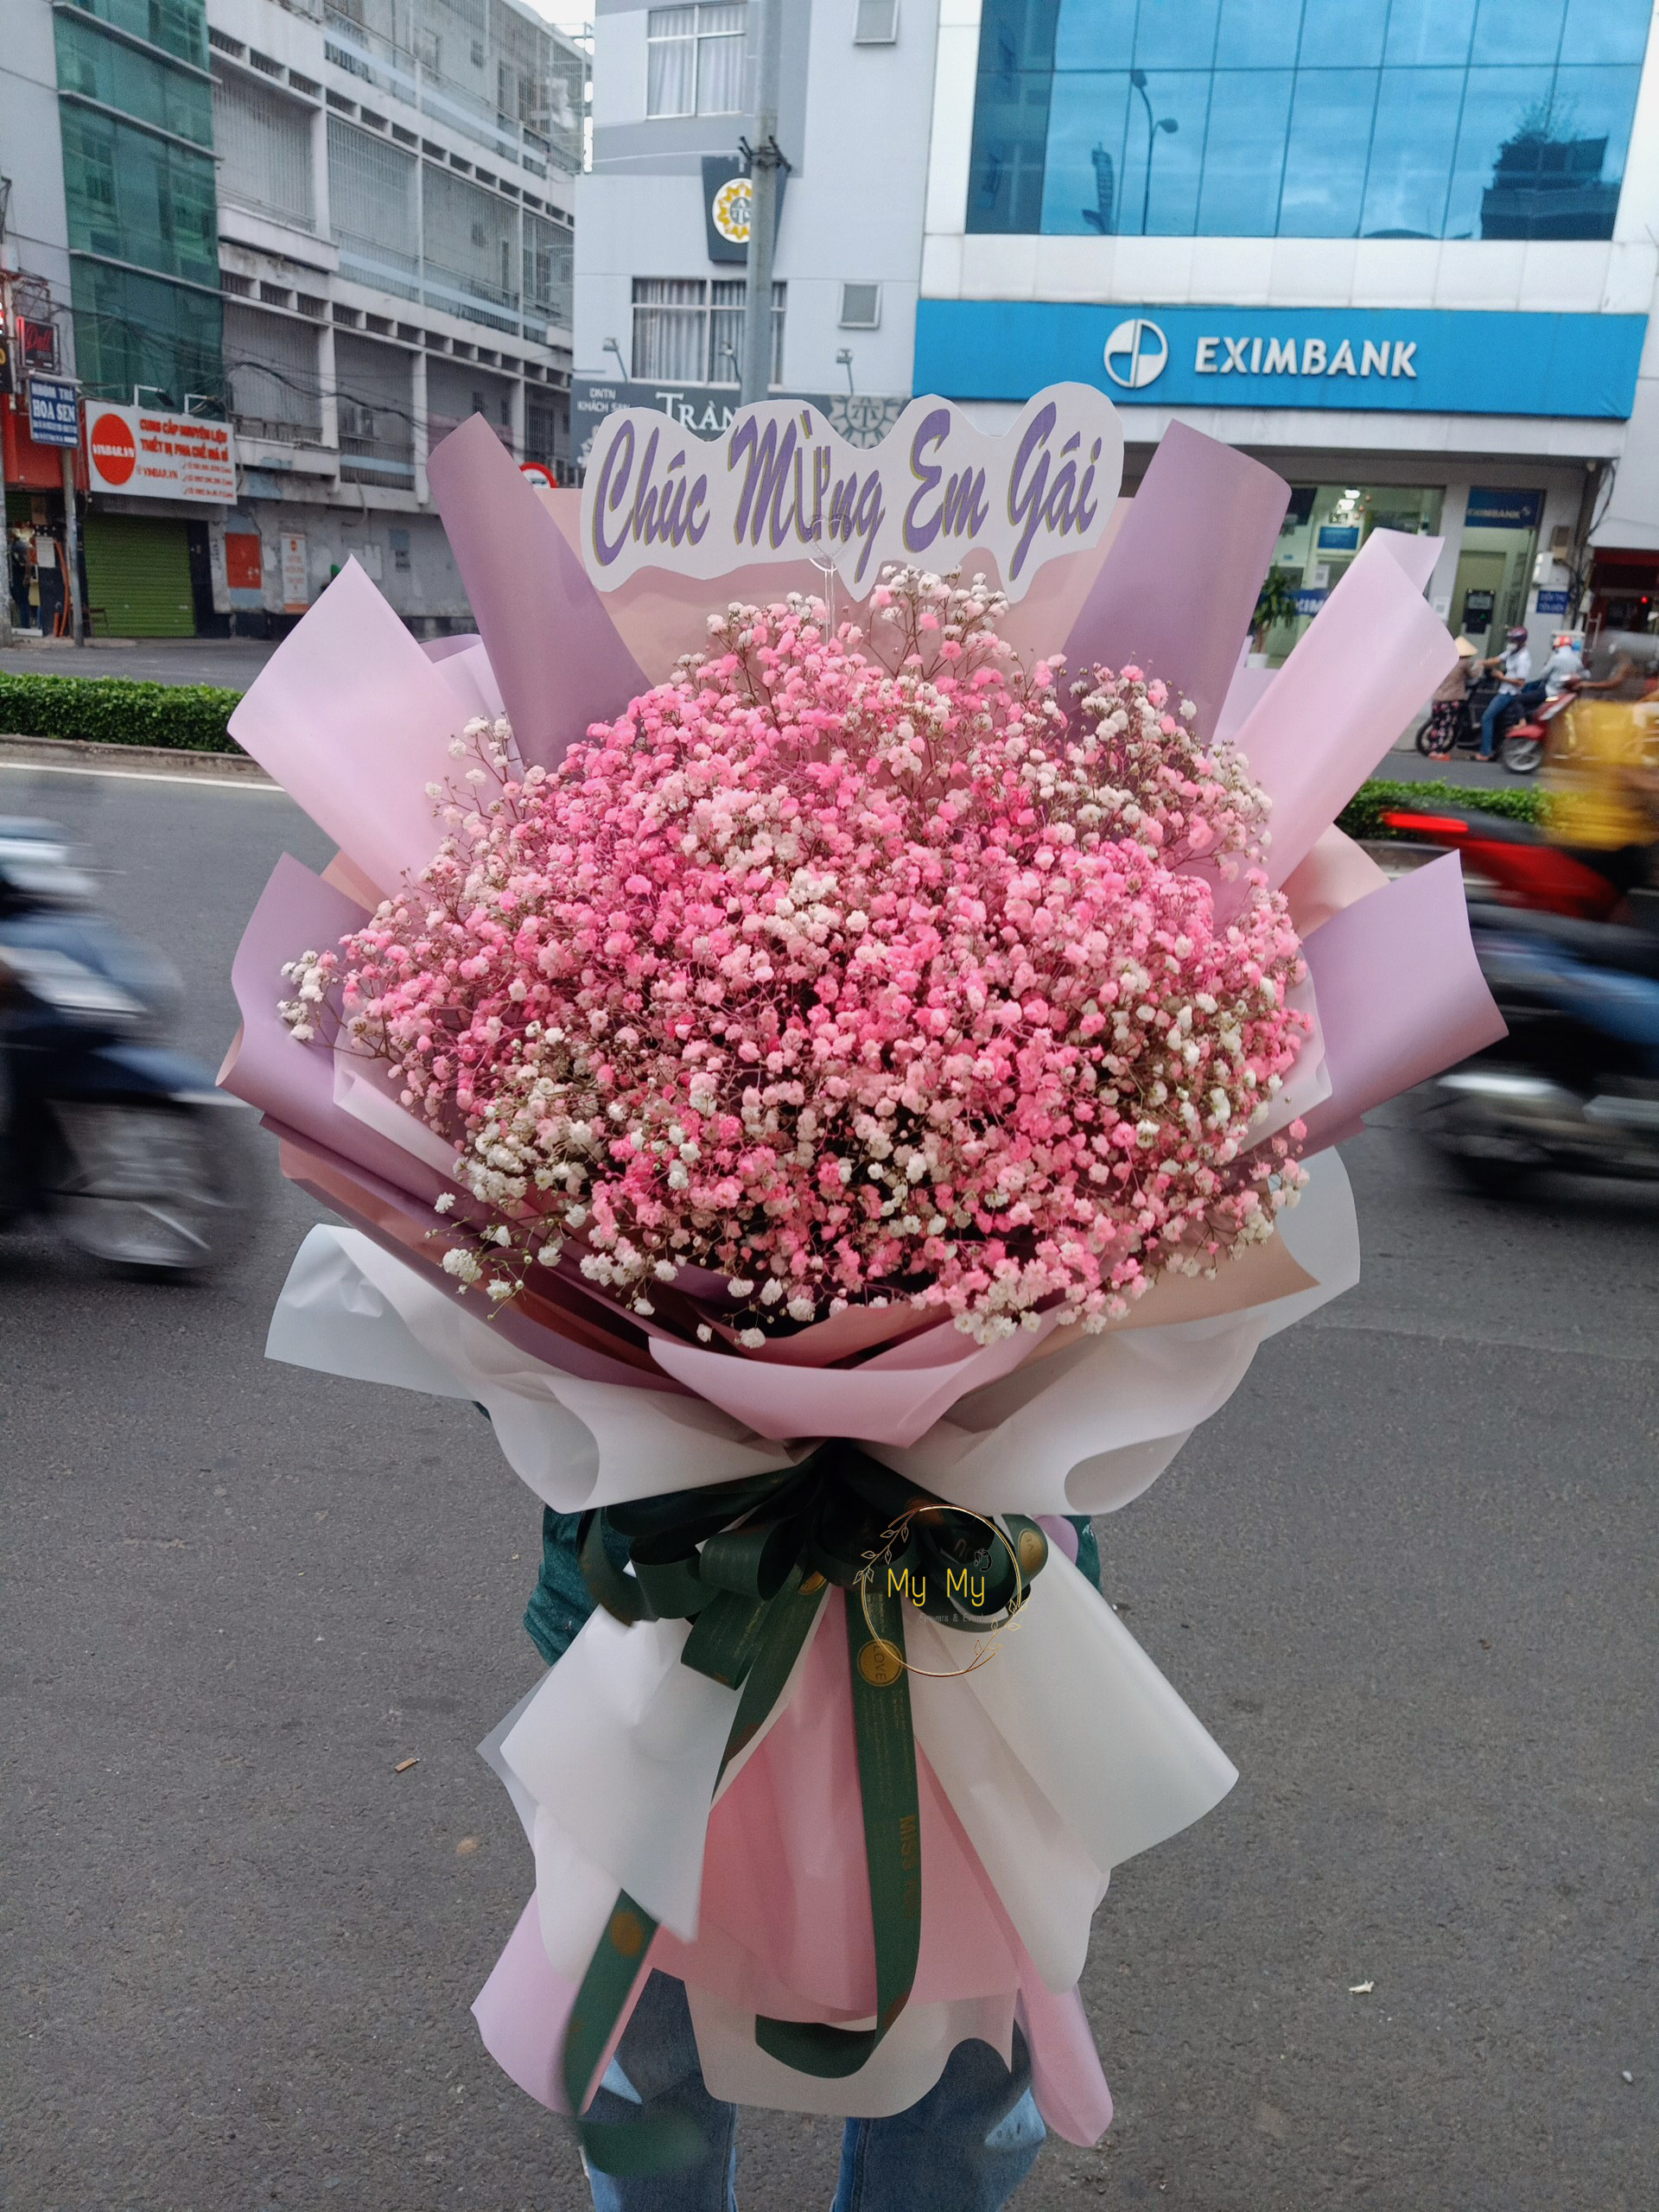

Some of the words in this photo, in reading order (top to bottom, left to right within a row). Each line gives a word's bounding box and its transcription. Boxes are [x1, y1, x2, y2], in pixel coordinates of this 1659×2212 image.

[1195, 336, 1418, 378] EXIMBANK
[33, 398, 56, 421] HOA
[56, 403, 76, 423] SEN
[594, 419, 710, 566] Chúc
[903, 409, 989, 553] Em
[1007, 401, 1103, 582] Gái
[873, 1645, 887, 1681] LOVE
